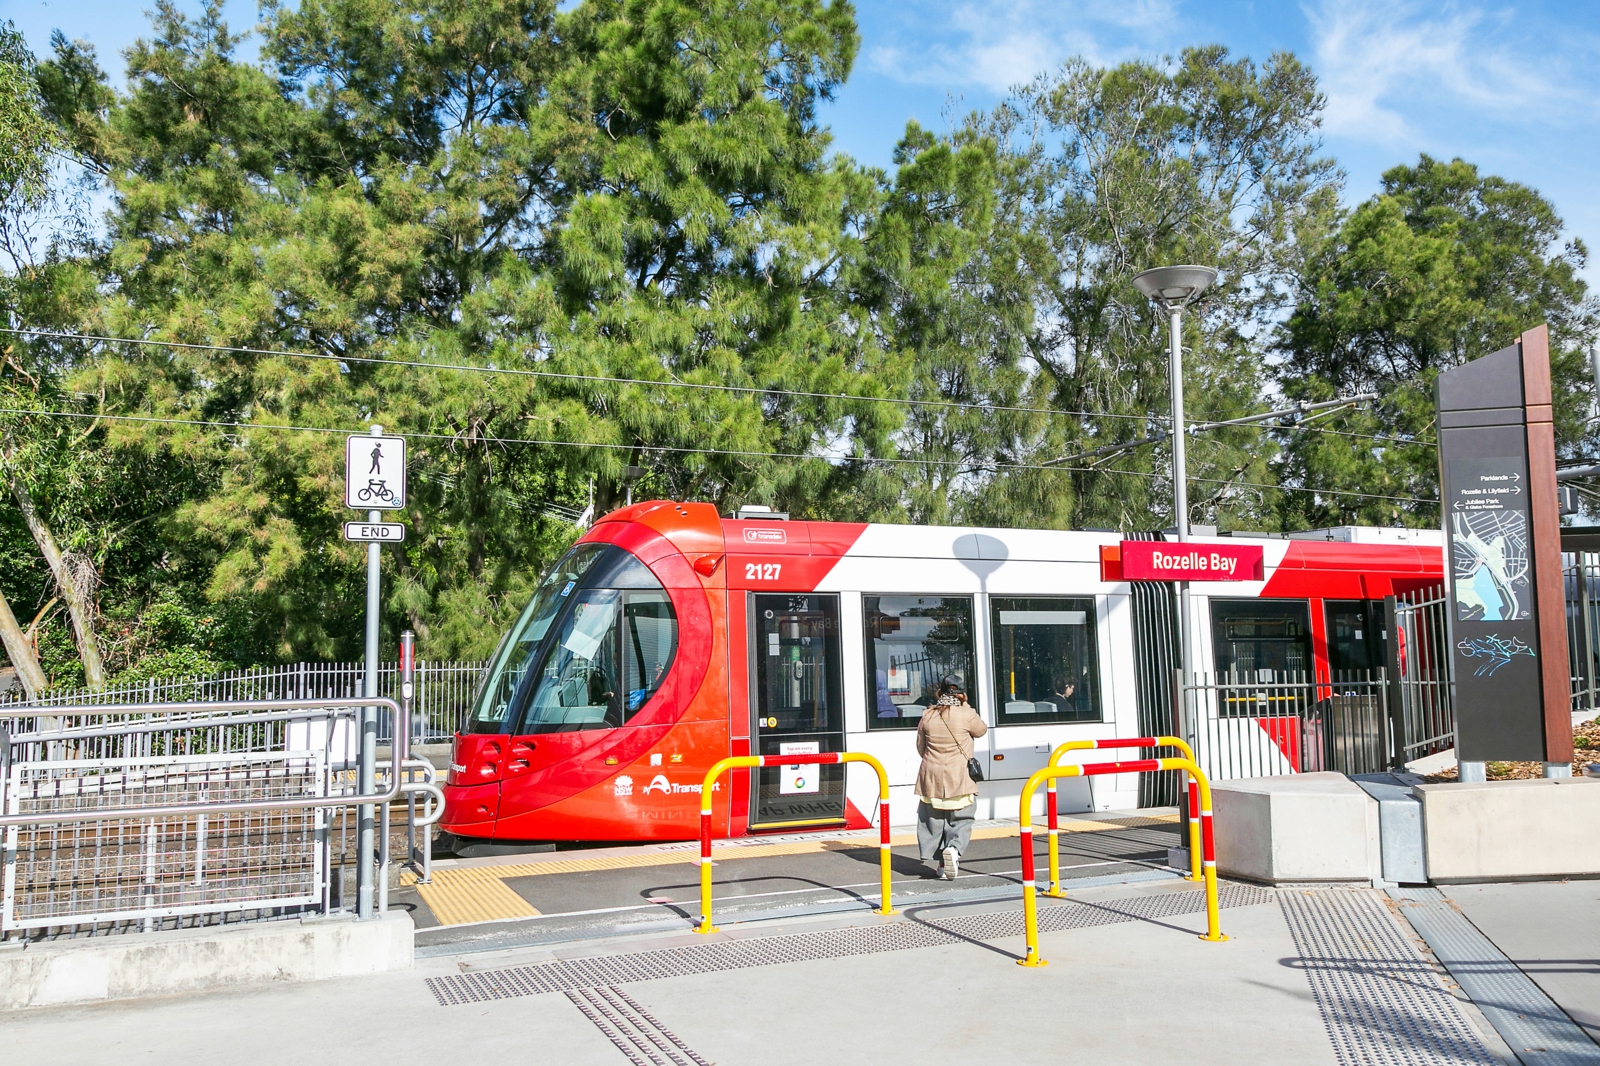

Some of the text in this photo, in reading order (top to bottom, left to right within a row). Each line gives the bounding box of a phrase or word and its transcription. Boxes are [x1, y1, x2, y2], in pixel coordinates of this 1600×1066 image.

[1488, 487, 1509, 495] Lilyfield
[361, 526, 390, 538] END
[1153, 551, 1237, 575] Rozelle Bay
[745, 563, 782, 580] 2127
[493, 704, 508, 721] 27
[614, 785, 633, 796] NSW
[671, 781, 720, 794] Transprt
